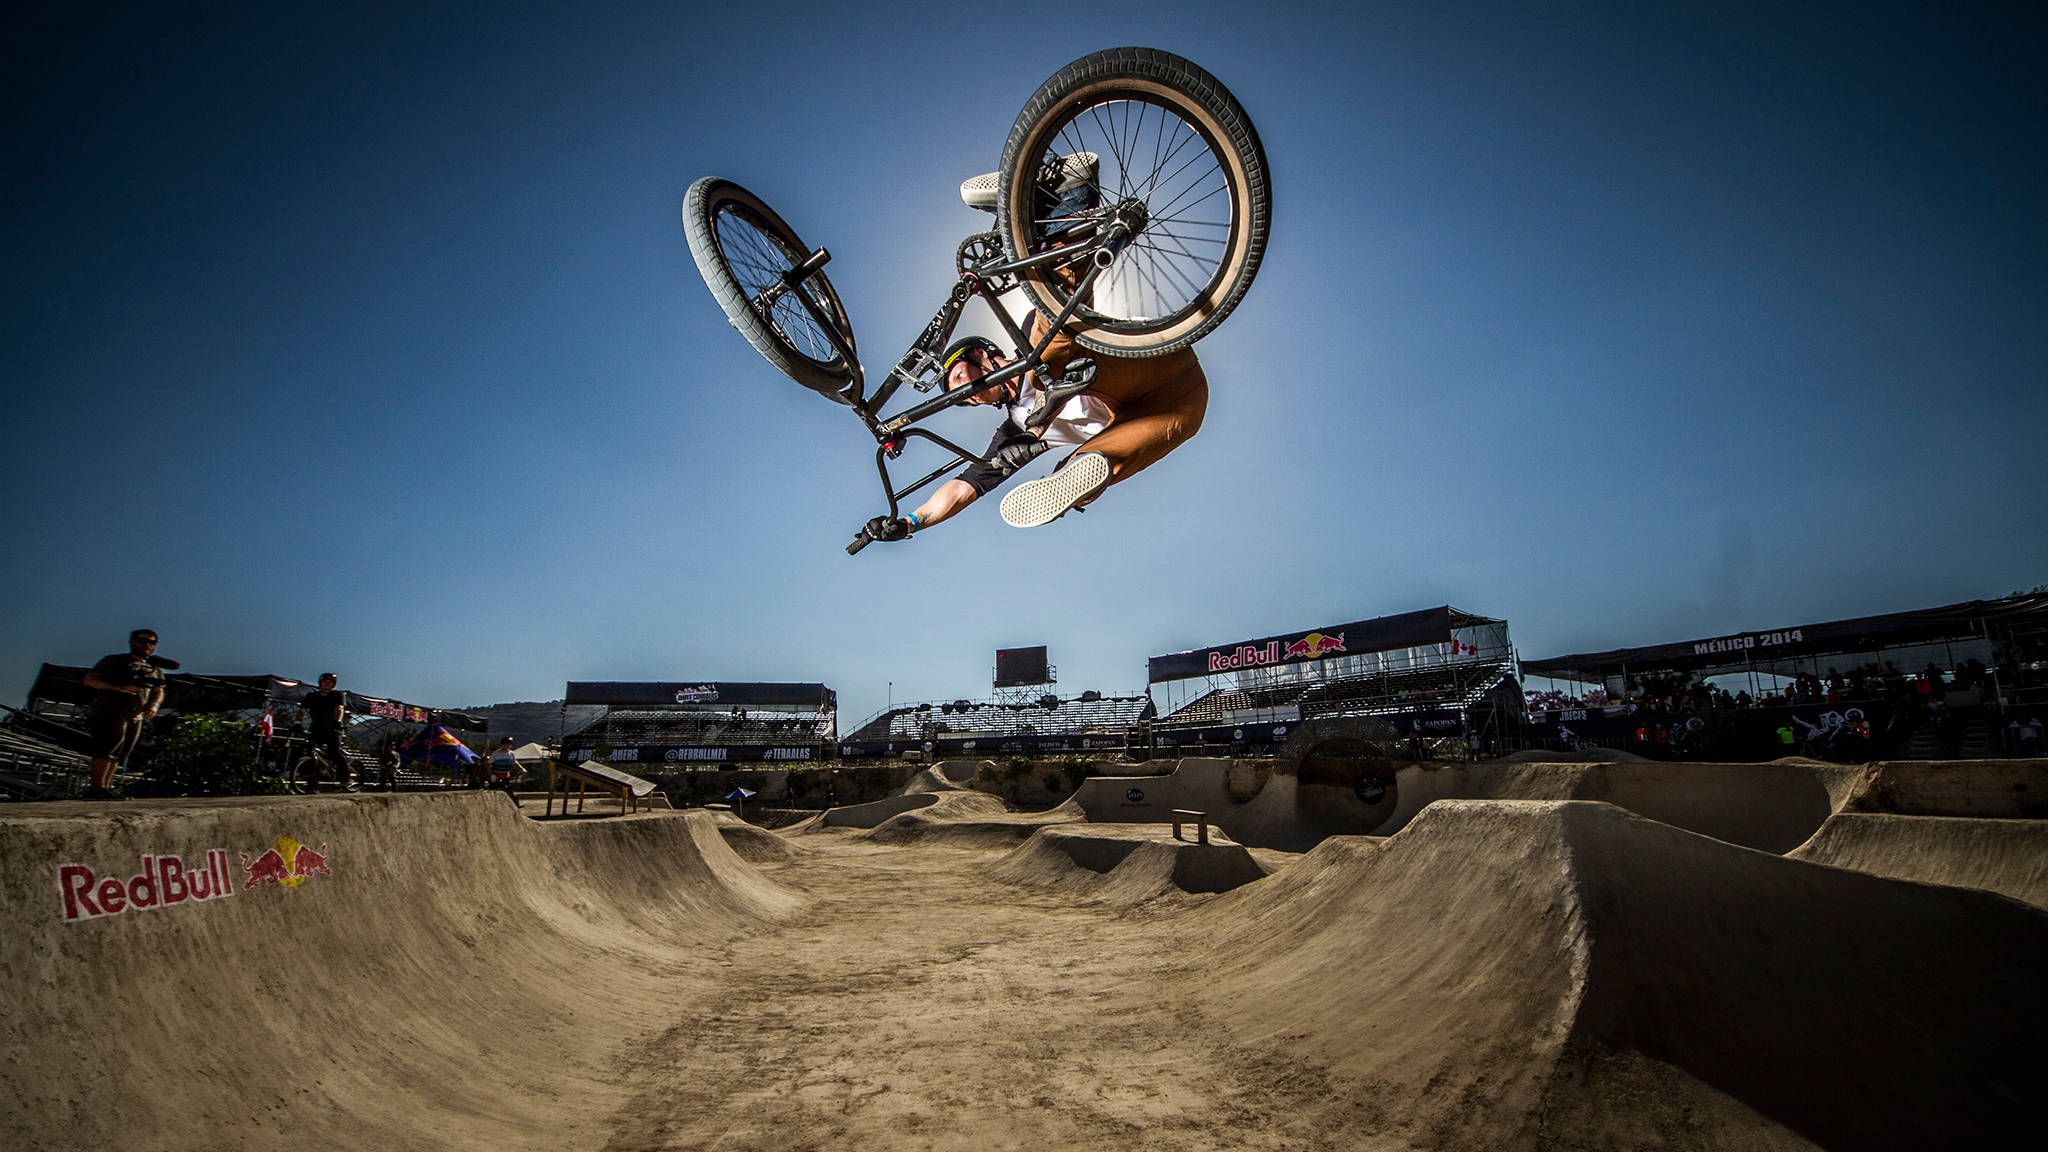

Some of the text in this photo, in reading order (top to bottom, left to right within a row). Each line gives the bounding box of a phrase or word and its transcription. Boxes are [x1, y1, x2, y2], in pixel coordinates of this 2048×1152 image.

[1208, 640, 1279, 672] Red Bull
[1694, 630, 1803, 655] MÉXICO 2014
[1560, 710, 1587, 721] JUECES
[58, 848, 235, 923] Red Bull
